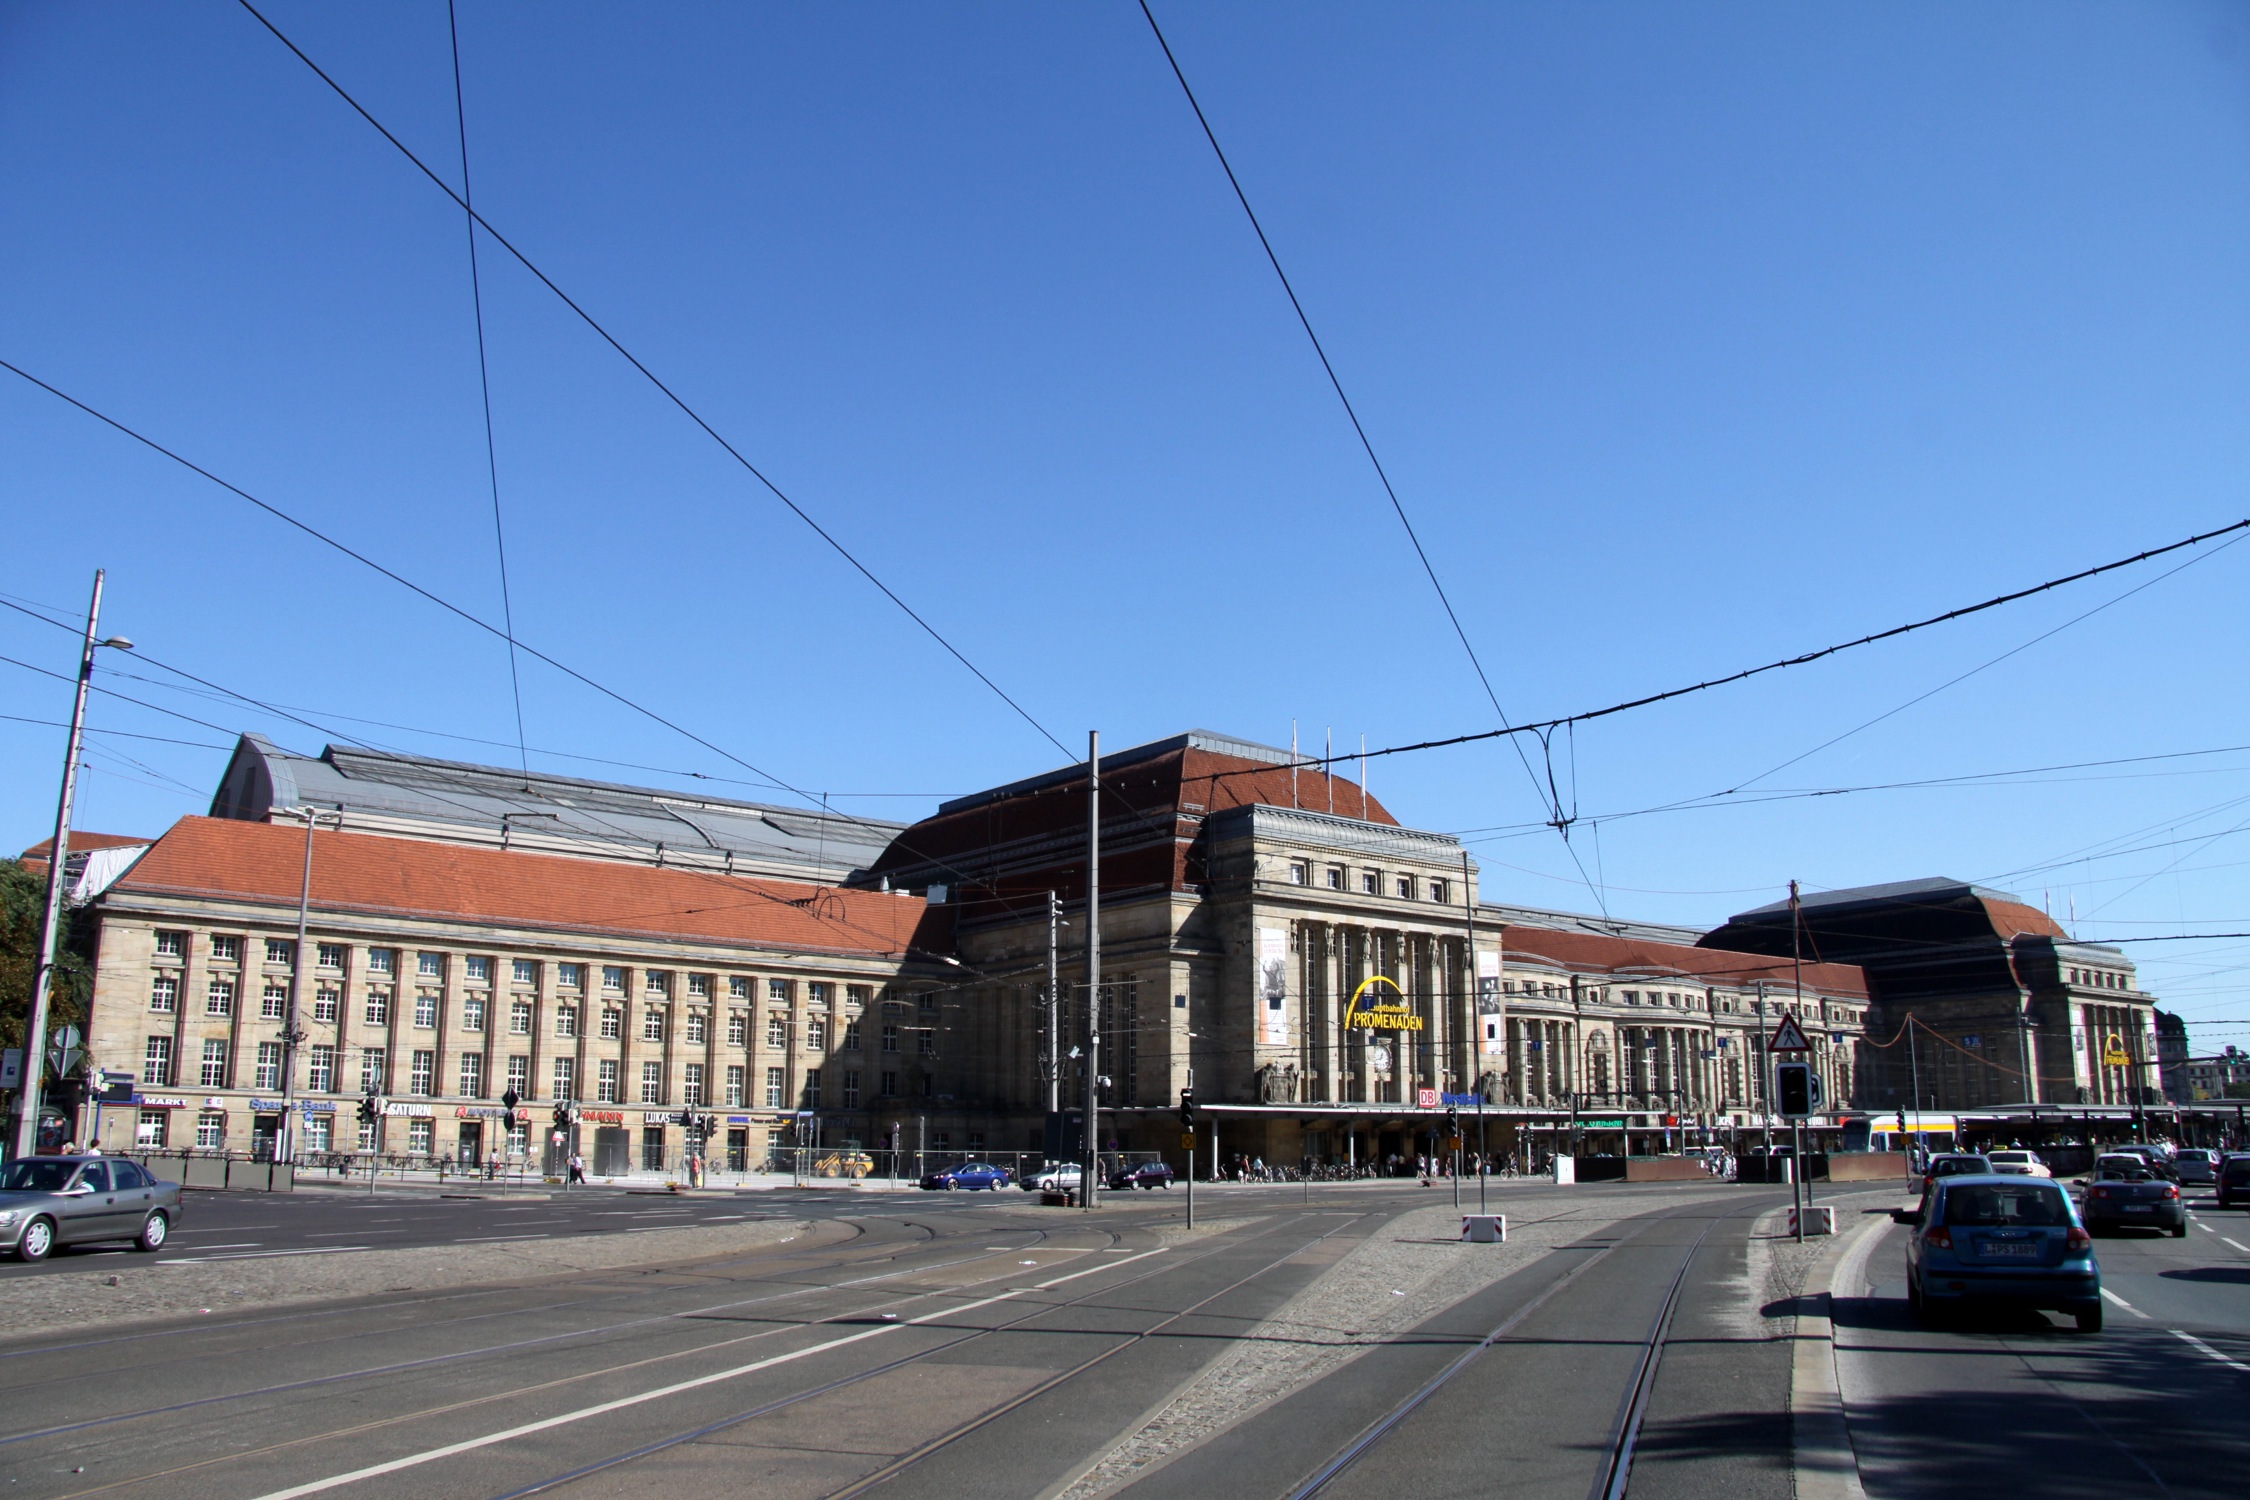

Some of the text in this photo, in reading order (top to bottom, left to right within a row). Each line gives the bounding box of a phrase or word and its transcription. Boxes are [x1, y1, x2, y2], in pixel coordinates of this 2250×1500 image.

[1370, 1004, 1411, 1013] auptbahnhof
[1354, 1012, 1423, 1030] PROMENADEN
[144, 1098, 188, 1106] MARKT
[1421, 1091, 1434, 1103] DB
[250, 1098, 337, 1111] Spara-Bank
[389, 1103, 432, 1116] SATURN
[645, 1111, 675, 1123] LUKAS
[1718, 1116, 1735, 1126] KFC
